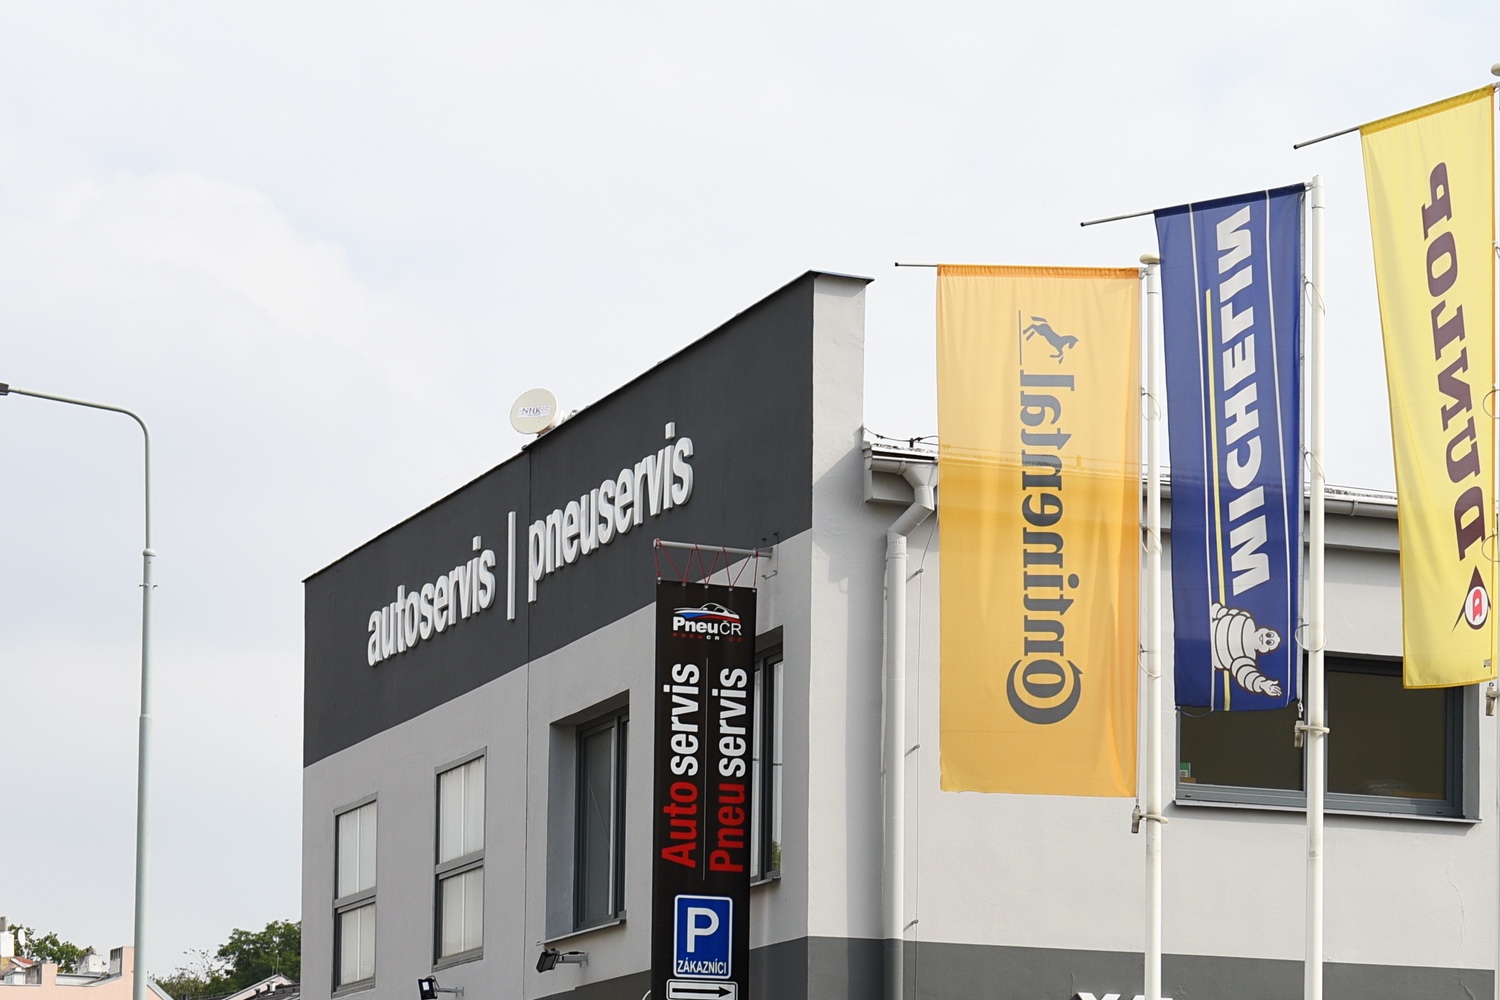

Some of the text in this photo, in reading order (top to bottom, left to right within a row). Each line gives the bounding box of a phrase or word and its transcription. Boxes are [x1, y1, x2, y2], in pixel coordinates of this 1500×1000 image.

[367, 422, 694, 666] autoservis pneuservis
[673, 616, 742, 636] PneuČR
[686, 907, 719, 952] P
[677, 957, 727, 977] ZÁKAZNÍCI
